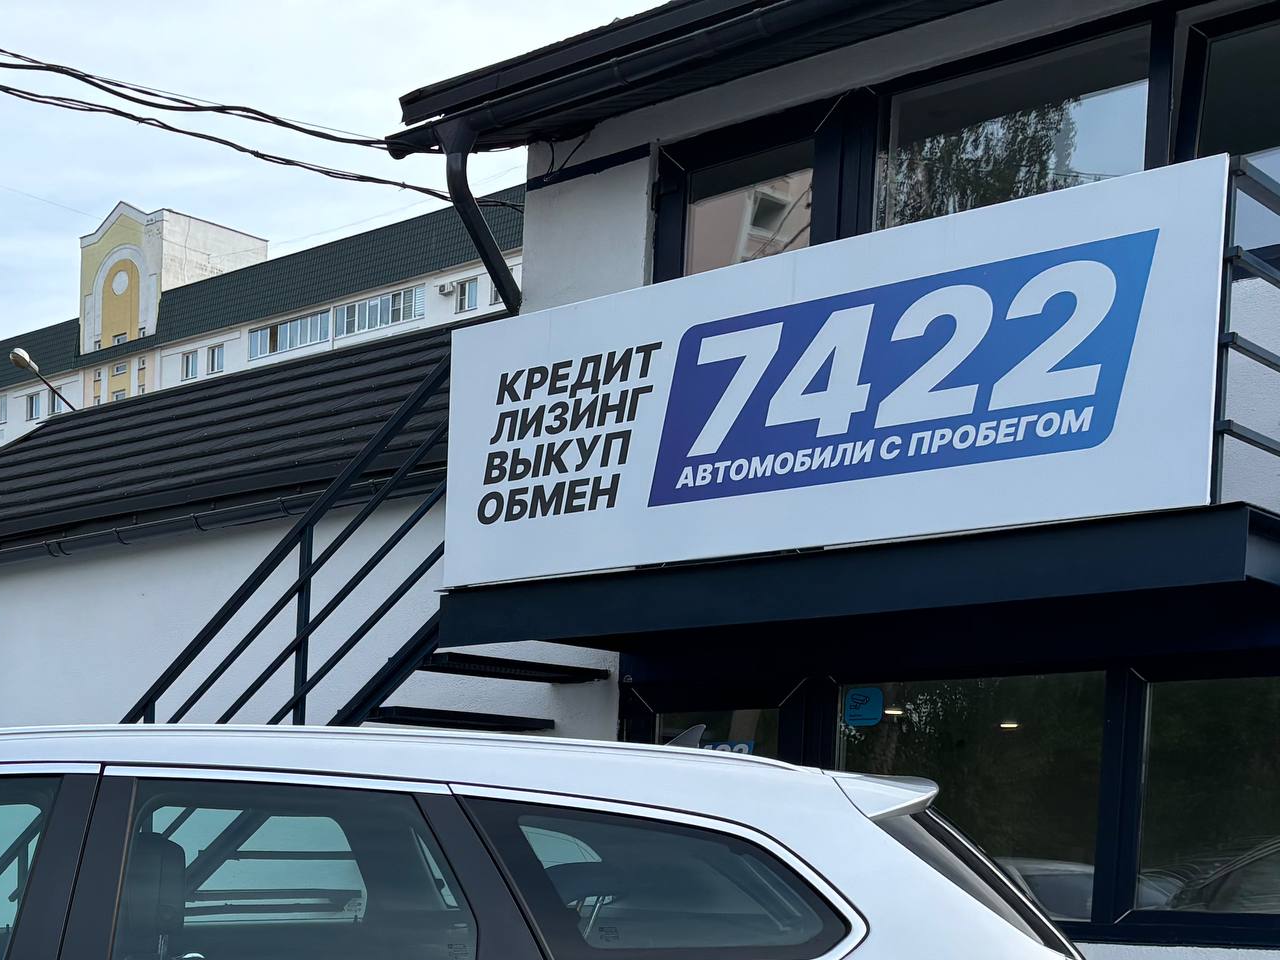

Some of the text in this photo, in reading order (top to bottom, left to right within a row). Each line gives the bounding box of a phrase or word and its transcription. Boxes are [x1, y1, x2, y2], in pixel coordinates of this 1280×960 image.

[495, 341, 663, 406] КРЕДИТ
[686, 260, 1117, 458] 7422
[489, 384, 654, 446] ЛИЗИНГ
[482, 429, 633, 486] ВЫКУП
[675, 406, 1094, 489] АВТОМОБИЛИ С ПРОБЕГОМ
[477, 472, 621, 526] ОБМЕН
